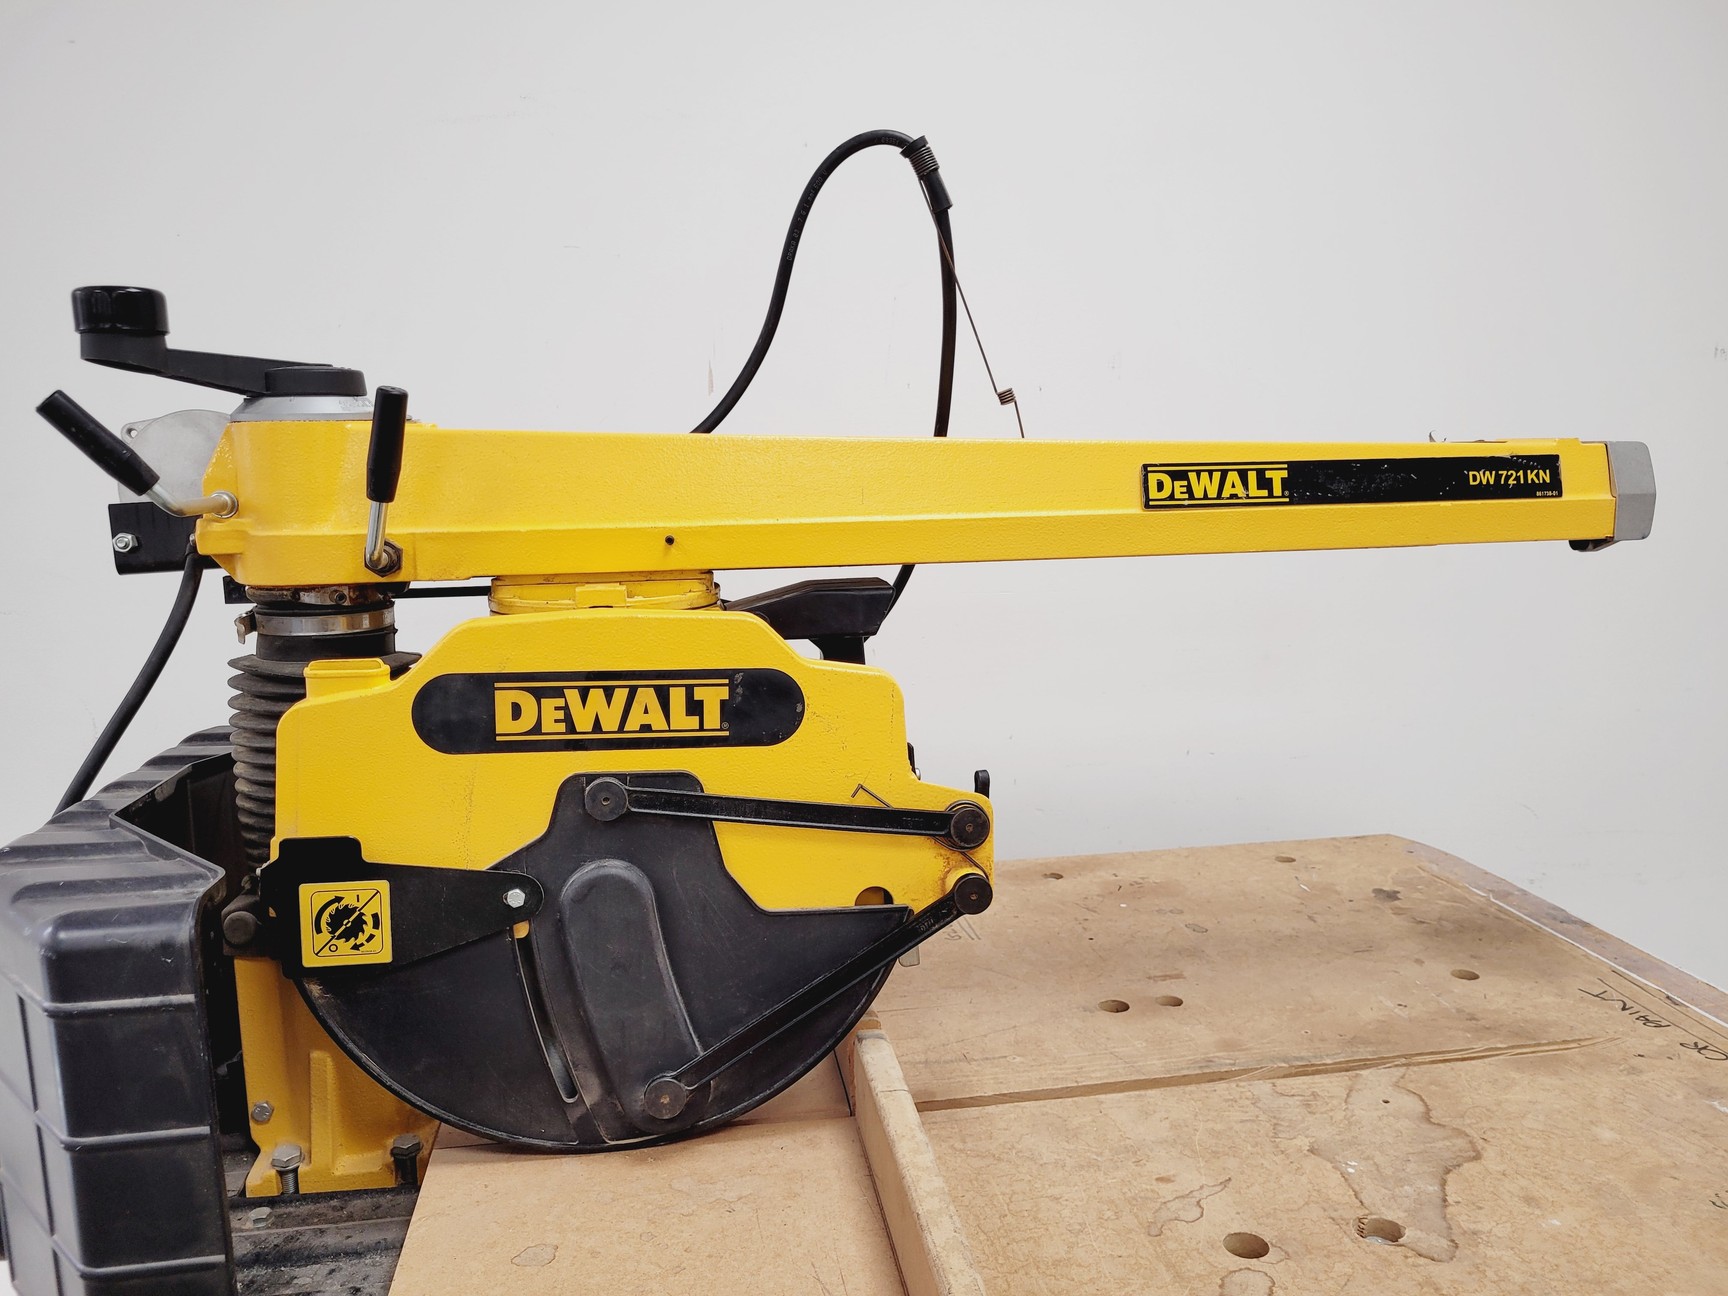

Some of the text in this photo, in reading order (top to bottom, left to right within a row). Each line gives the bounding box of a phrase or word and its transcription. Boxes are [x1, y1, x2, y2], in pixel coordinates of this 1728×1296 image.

[1469, 469, 1550, 485] DW 721 KN
[1578, 988, 1671, 1029] PAINT
